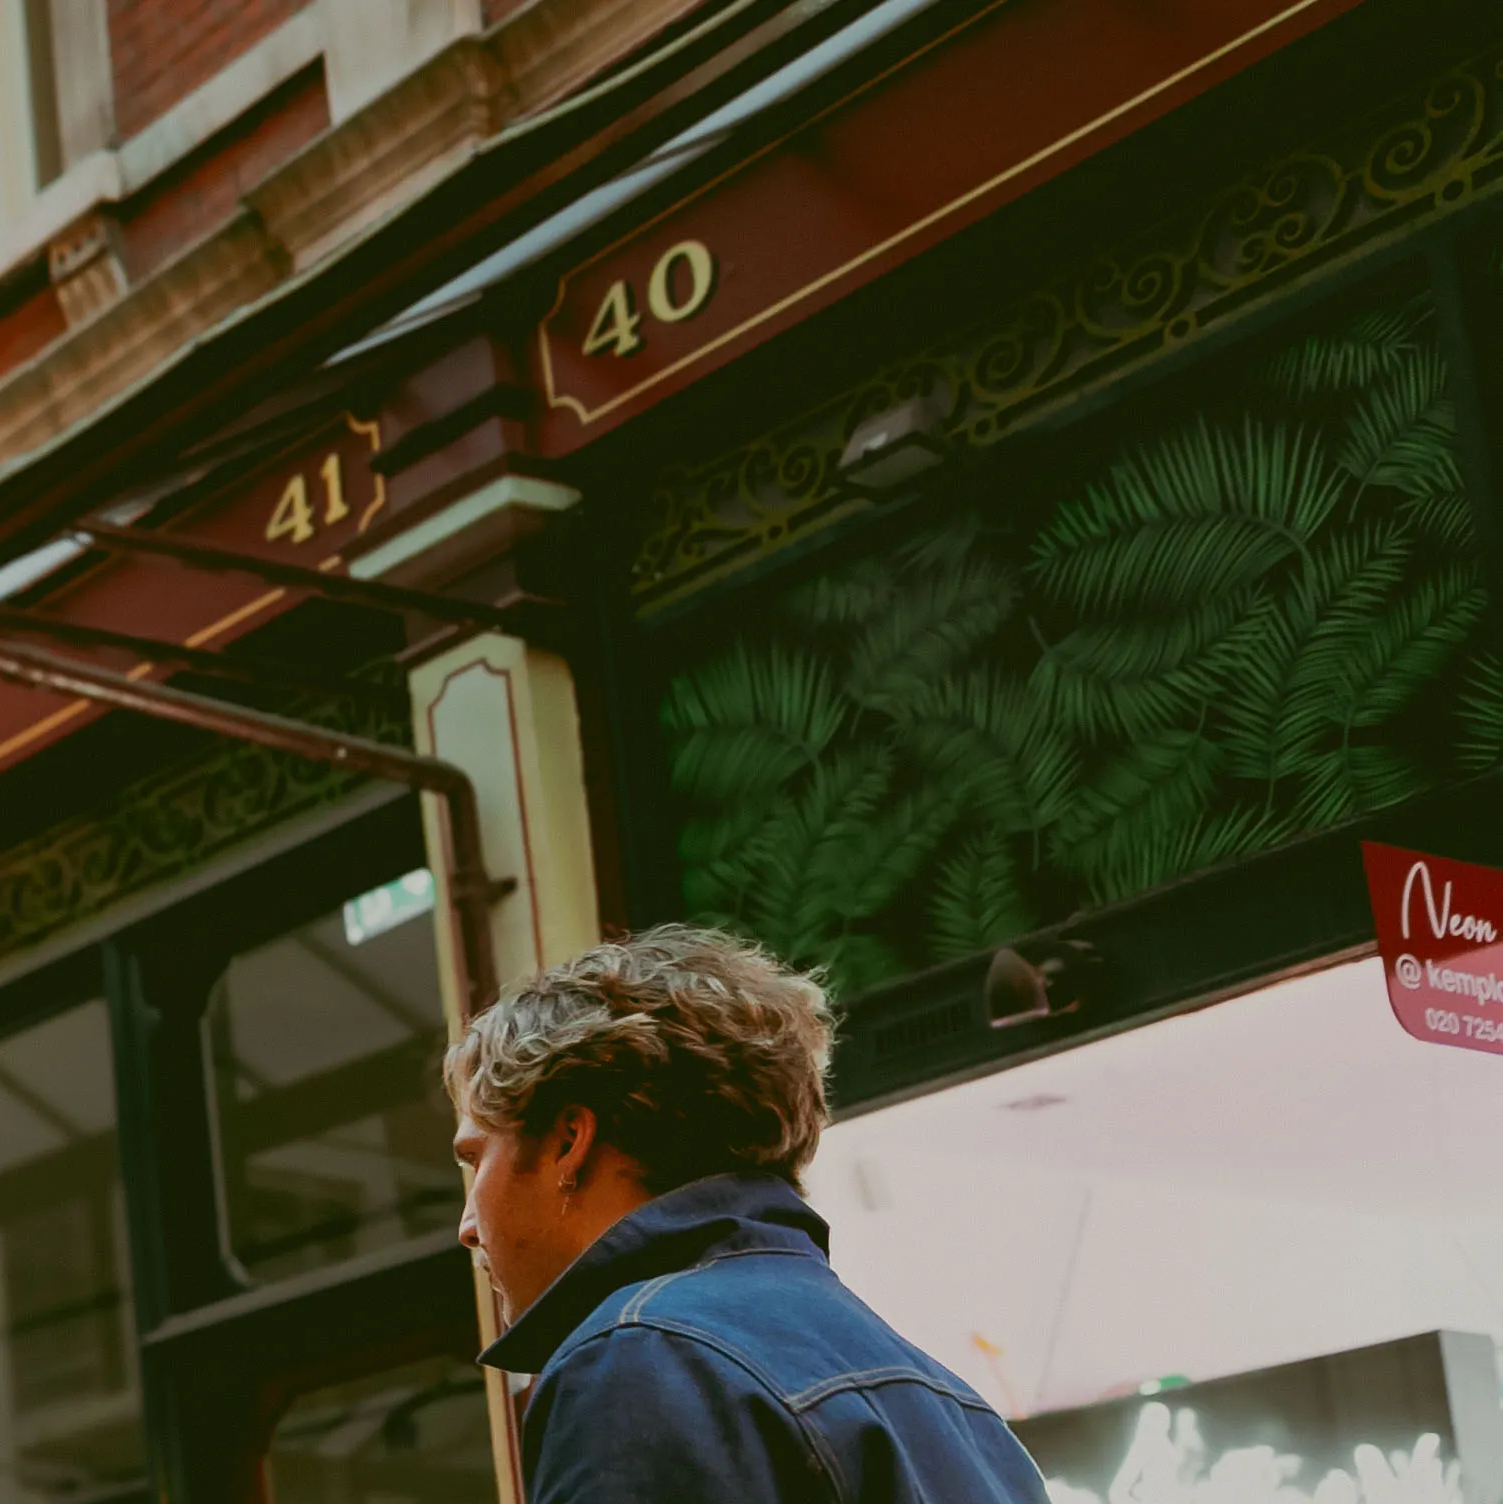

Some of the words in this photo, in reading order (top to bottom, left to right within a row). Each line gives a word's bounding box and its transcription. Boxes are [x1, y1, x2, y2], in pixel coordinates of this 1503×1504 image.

[581, 239, 712, 357] 40
[266, 453, 350, 544] 41
[1401, 860, 1497, 943] Neon
